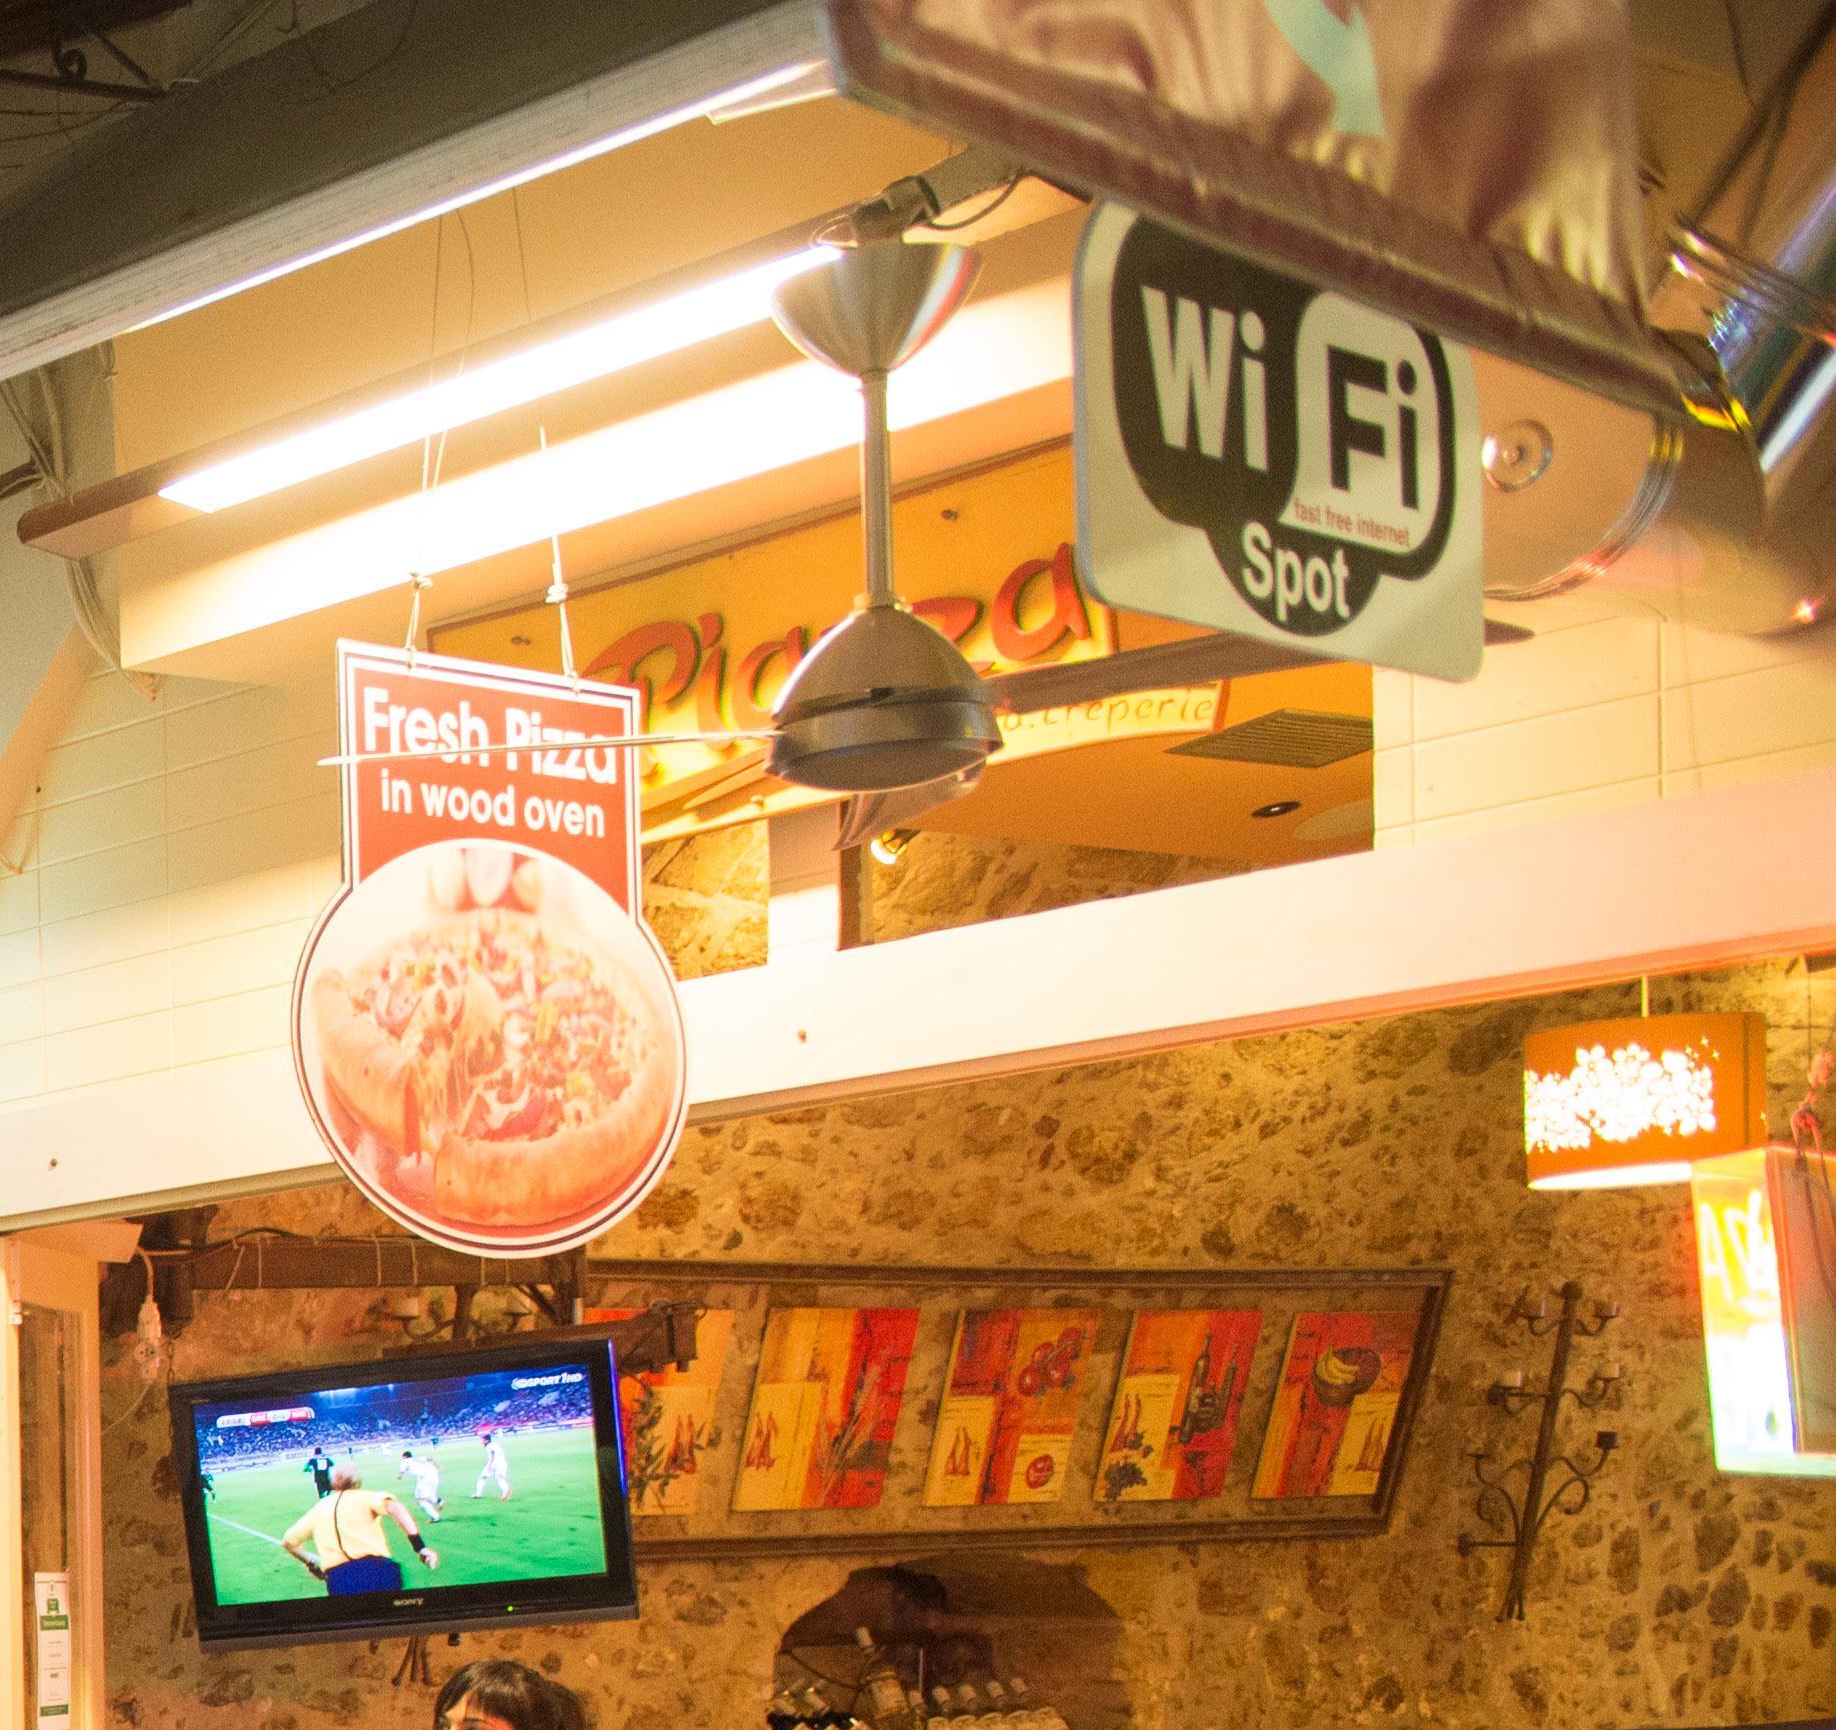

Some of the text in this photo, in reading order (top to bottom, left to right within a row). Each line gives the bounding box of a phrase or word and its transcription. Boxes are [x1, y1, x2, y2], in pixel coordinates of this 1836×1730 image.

[1325, 507, 1352, 532] free
[1356, 516, 1411, 547] internet
[1243, 521, 1350, 621] Spot
[363, 686, 618, 785] Fresh Pizza
[380, 769, 605, 838] in wood oven
